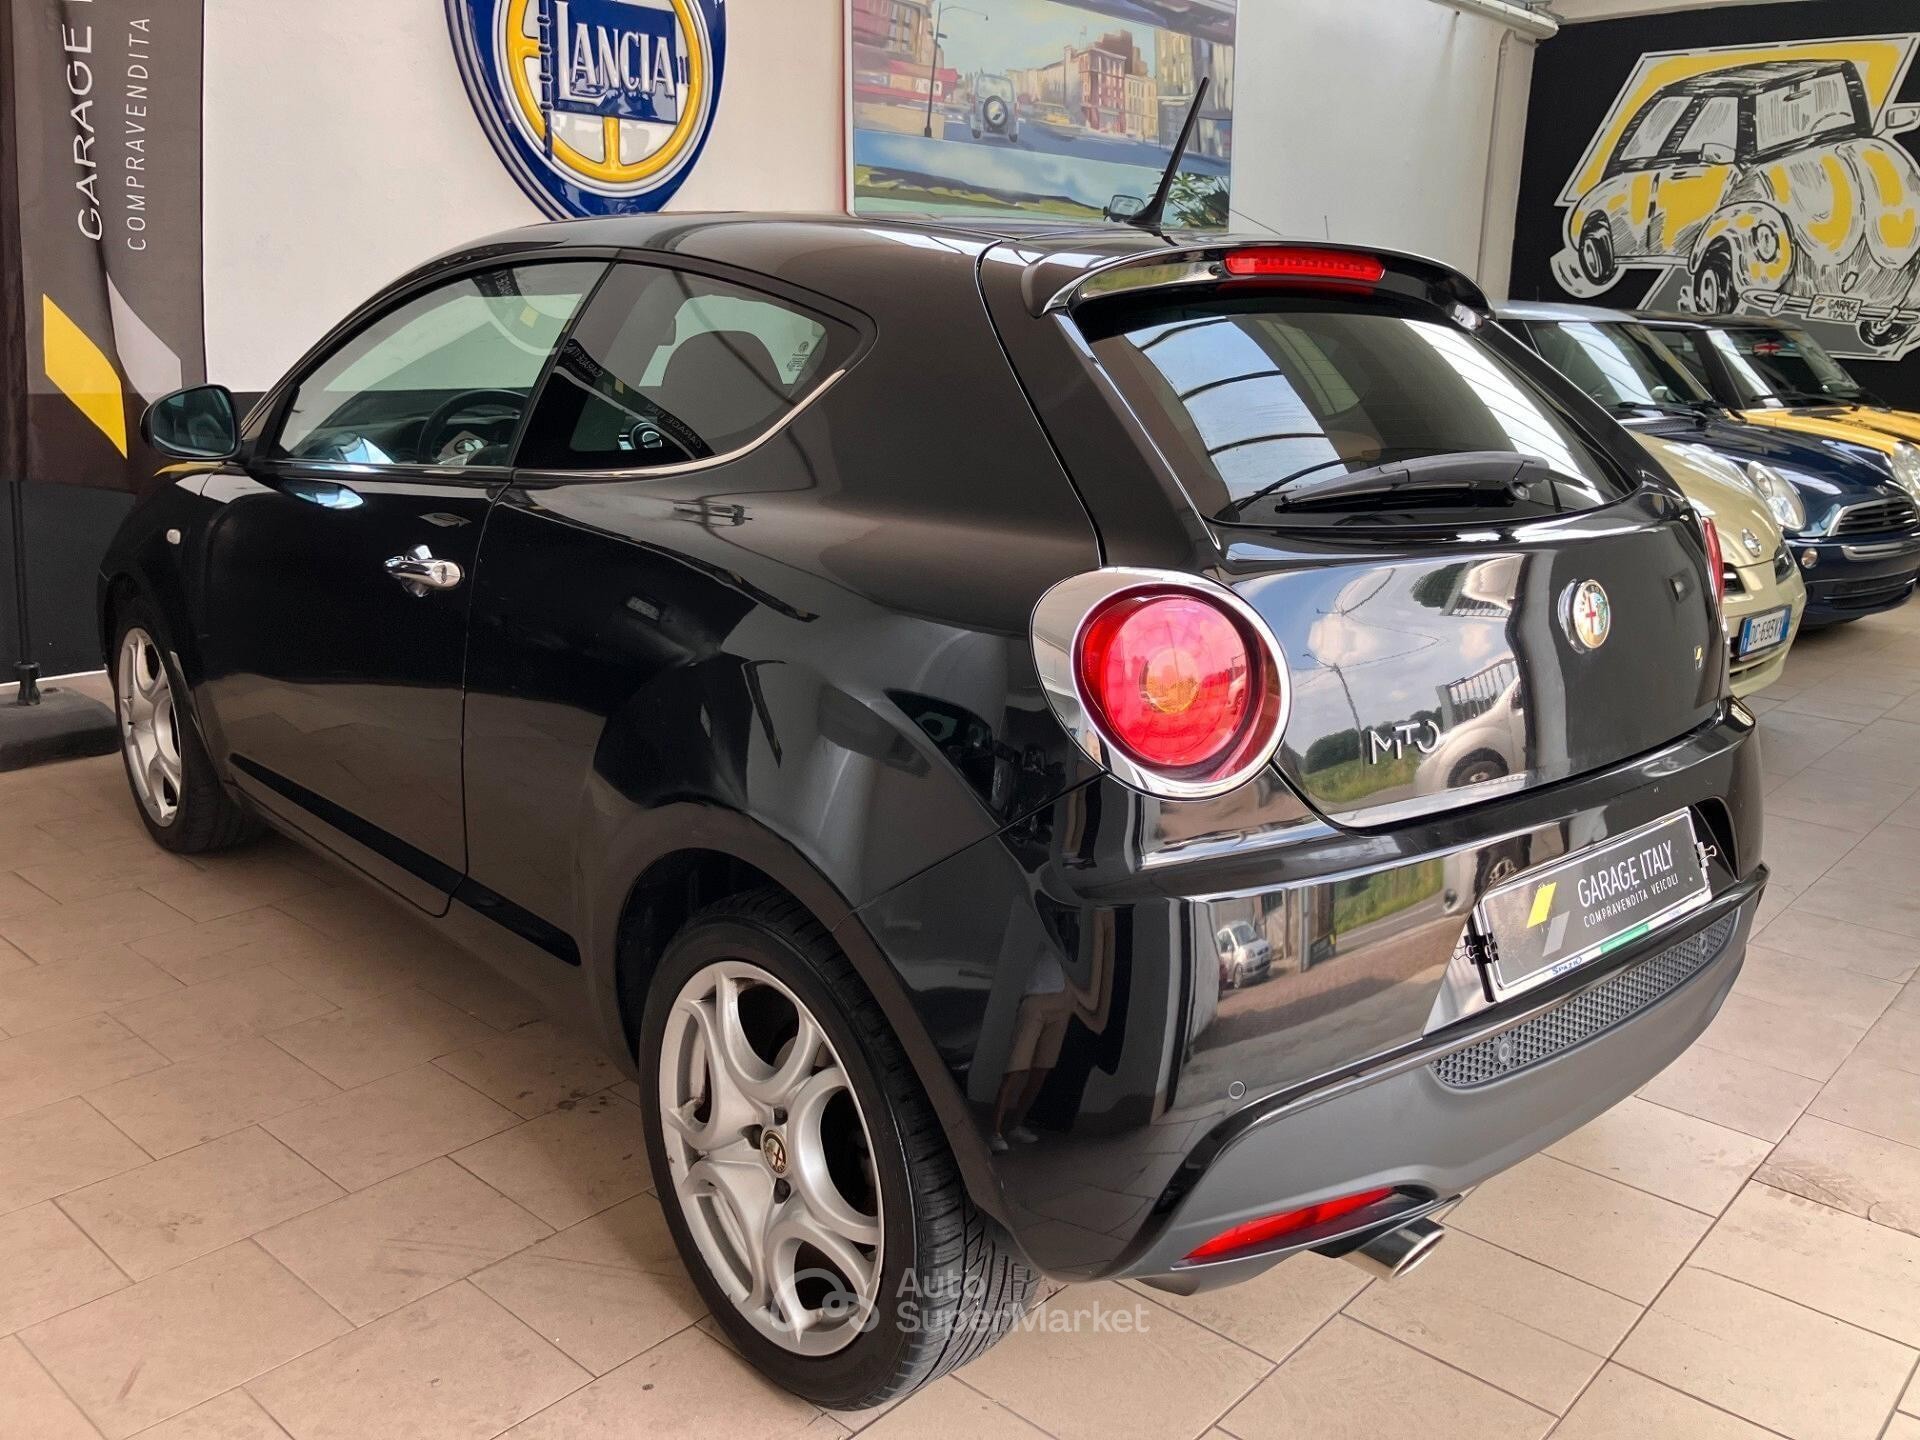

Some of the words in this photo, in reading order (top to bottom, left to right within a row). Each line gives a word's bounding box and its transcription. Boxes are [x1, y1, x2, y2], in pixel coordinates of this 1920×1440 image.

[554, 0, 676, 107] LANCIA
[62, 24, 102, 240] GARAGE
[125, 17, 151, 251] COMPRAVENDITA
[1829, 310, 1855, 321] ITALY
[1577, 856, 1640, 908] GARAGE
[1640, 839, 1673, 880] ITALY
[1583, 889, 1649, 928] COMPRAVENDITA
[1650, 873, 1679, 895] VEICOLI
